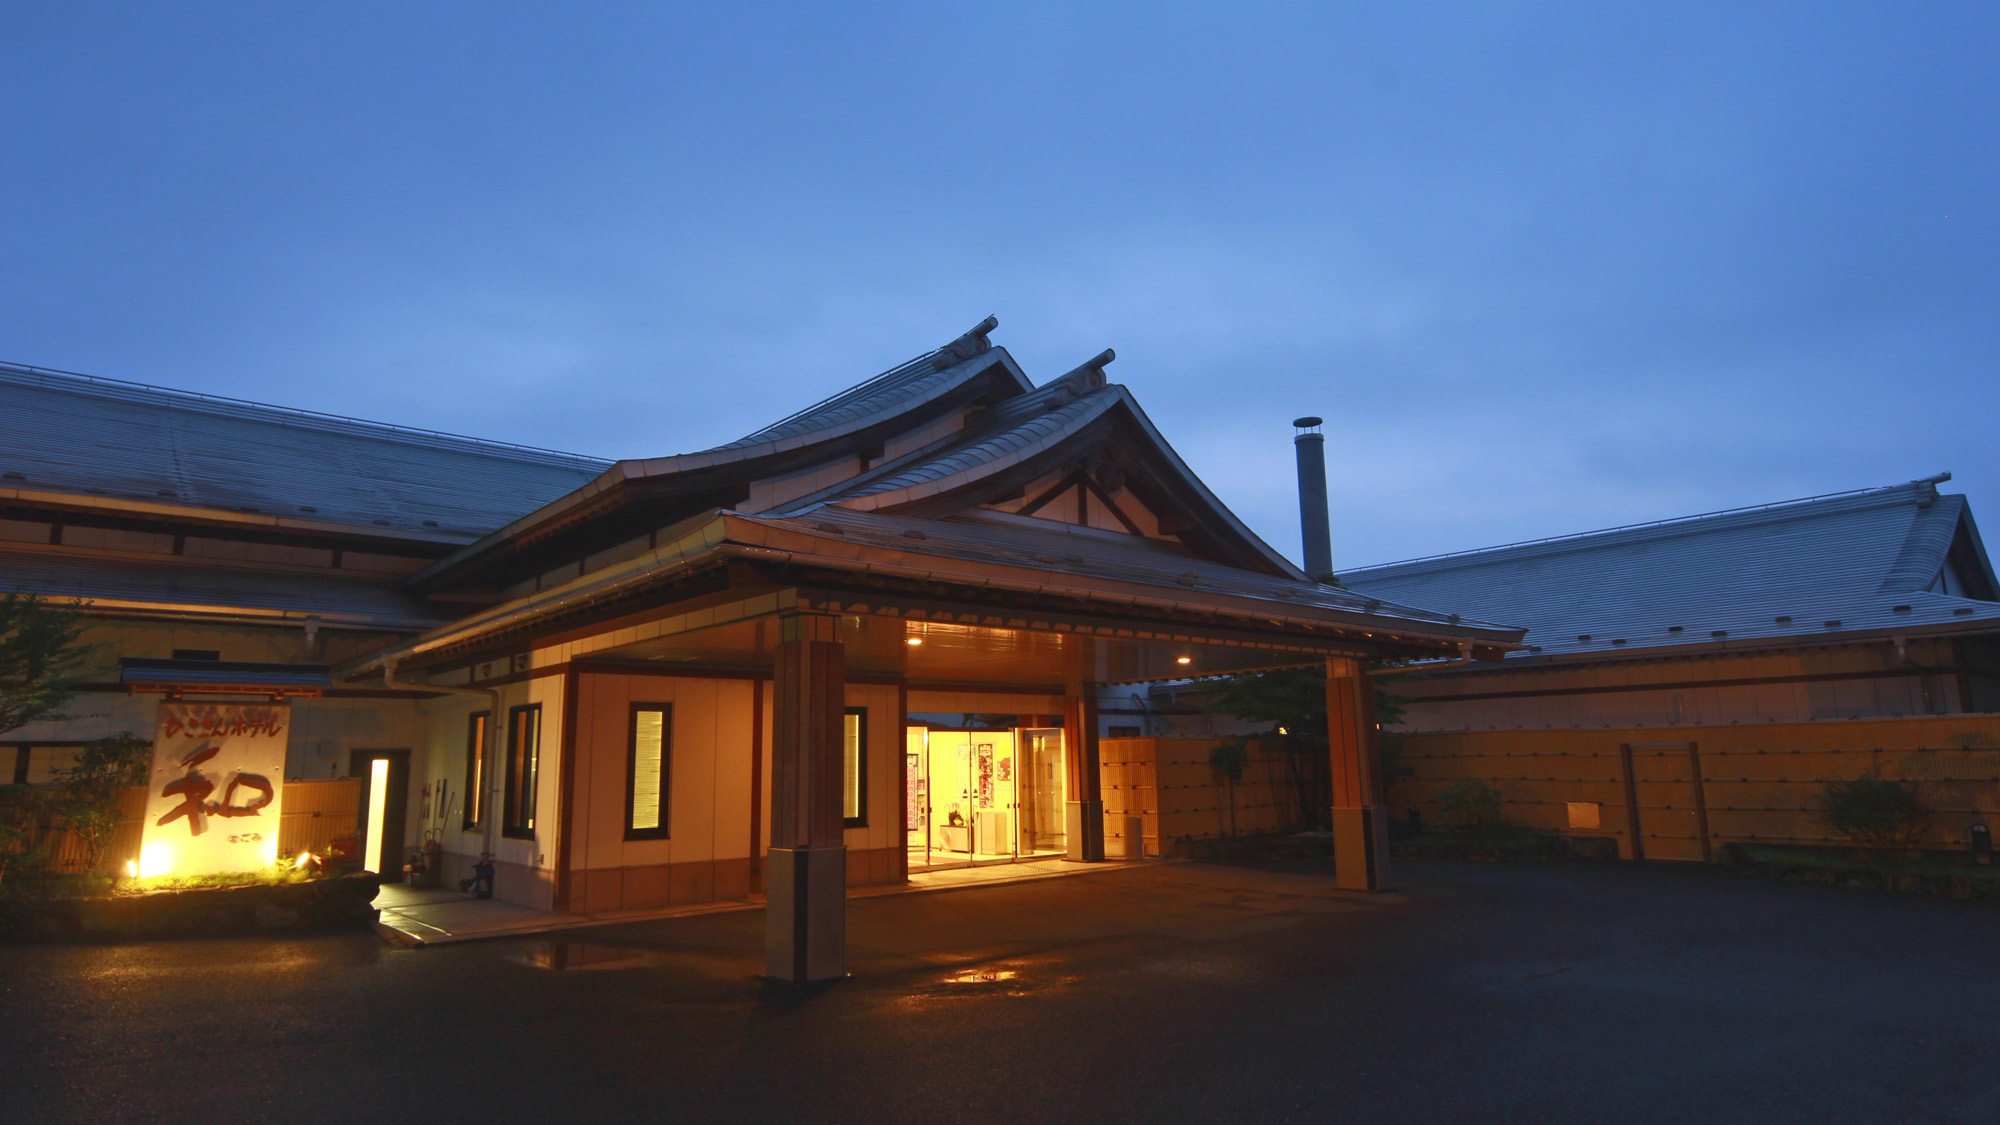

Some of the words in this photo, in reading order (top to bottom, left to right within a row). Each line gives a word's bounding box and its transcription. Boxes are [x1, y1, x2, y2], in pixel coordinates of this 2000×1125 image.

[165, 716, 283, 738] ひこさんホテル
[156, 747, 274, 837] 和
